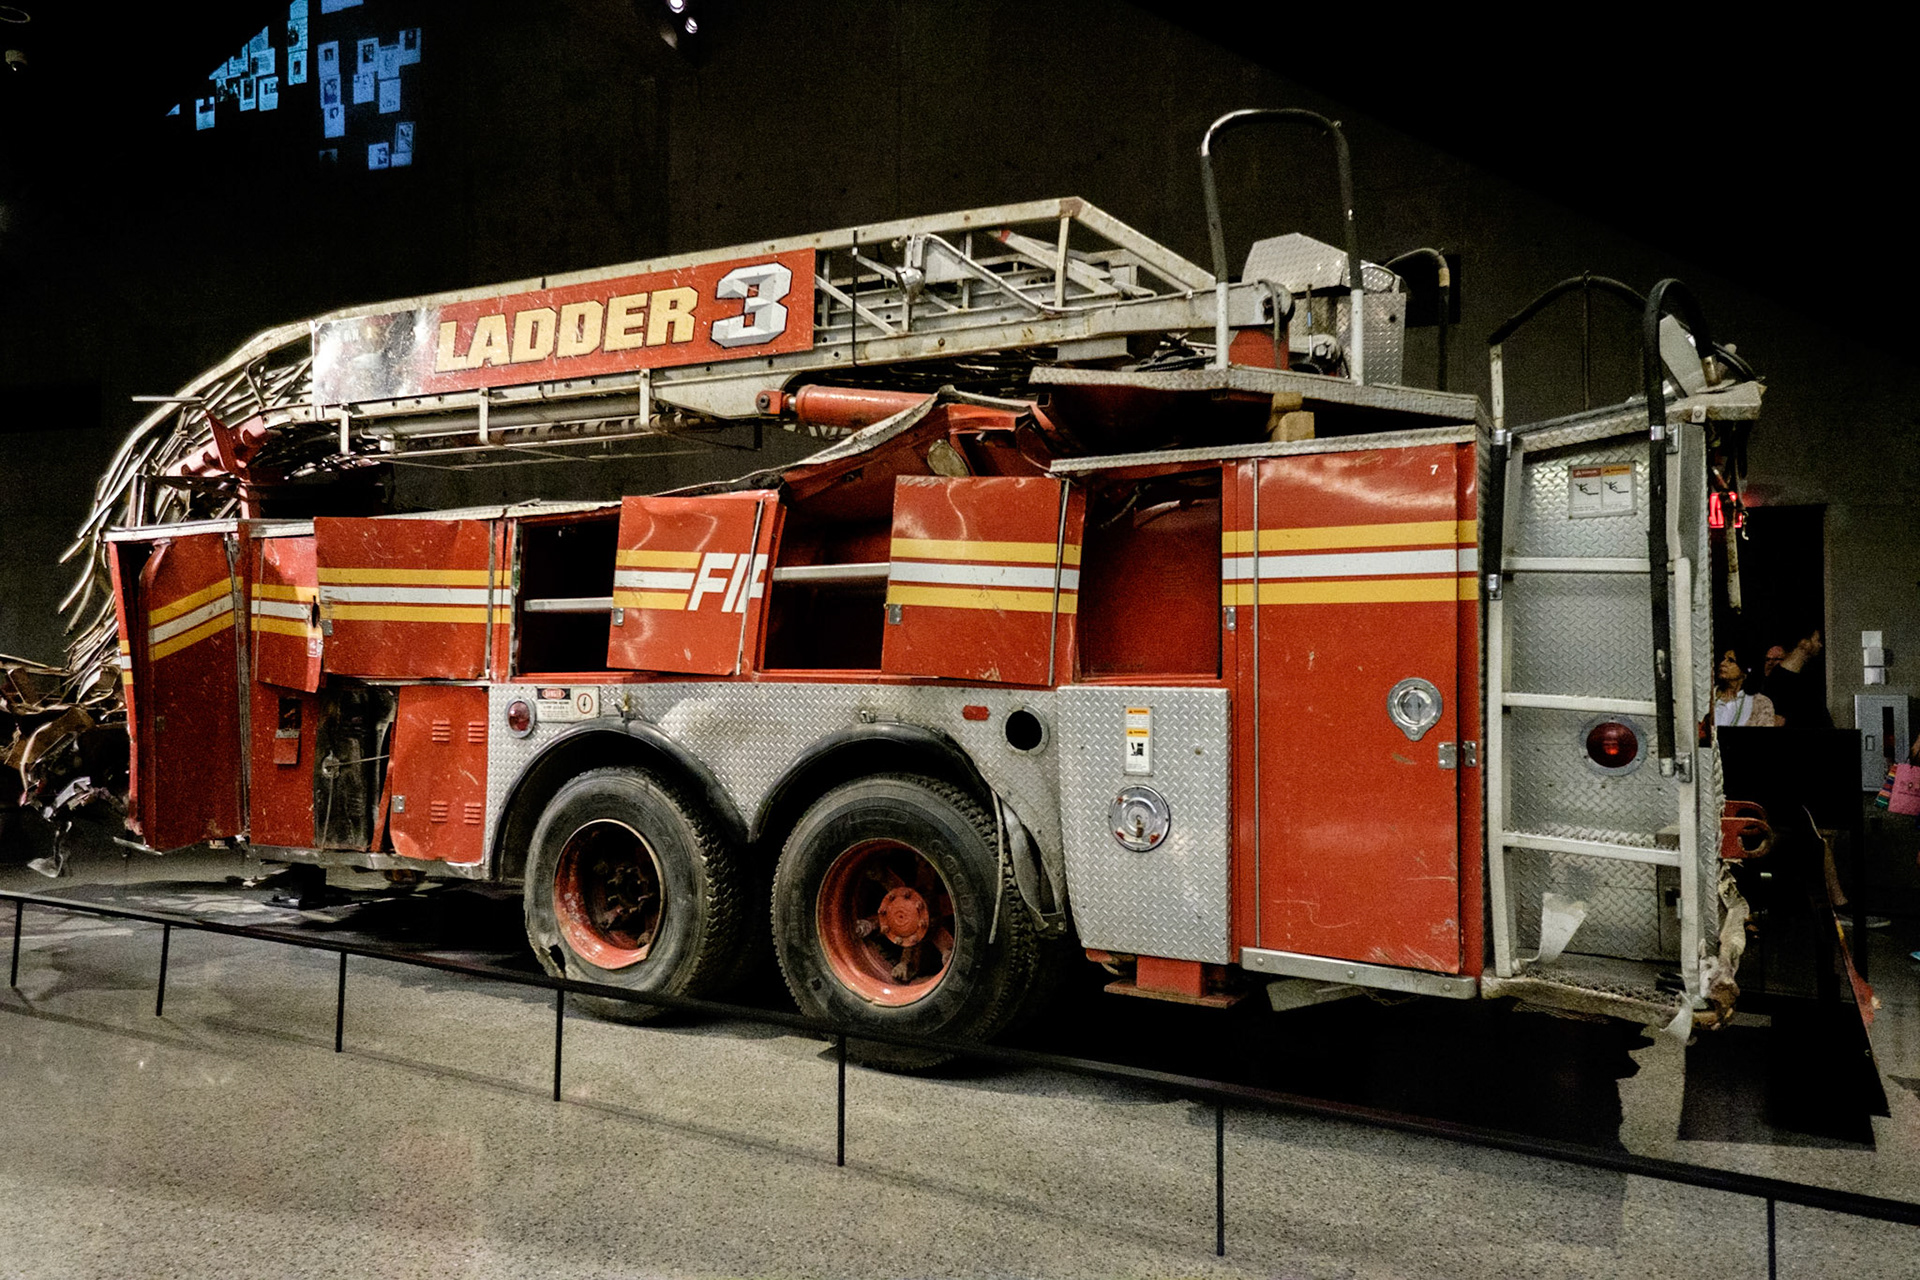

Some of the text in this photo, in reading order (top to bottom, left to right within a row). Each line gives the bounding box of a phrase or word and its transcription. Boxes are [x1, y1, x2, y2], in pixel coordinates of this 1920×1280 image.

[434, 261, 793, 374] LADDER 3
[1430, 464, 1439, 476] 7
